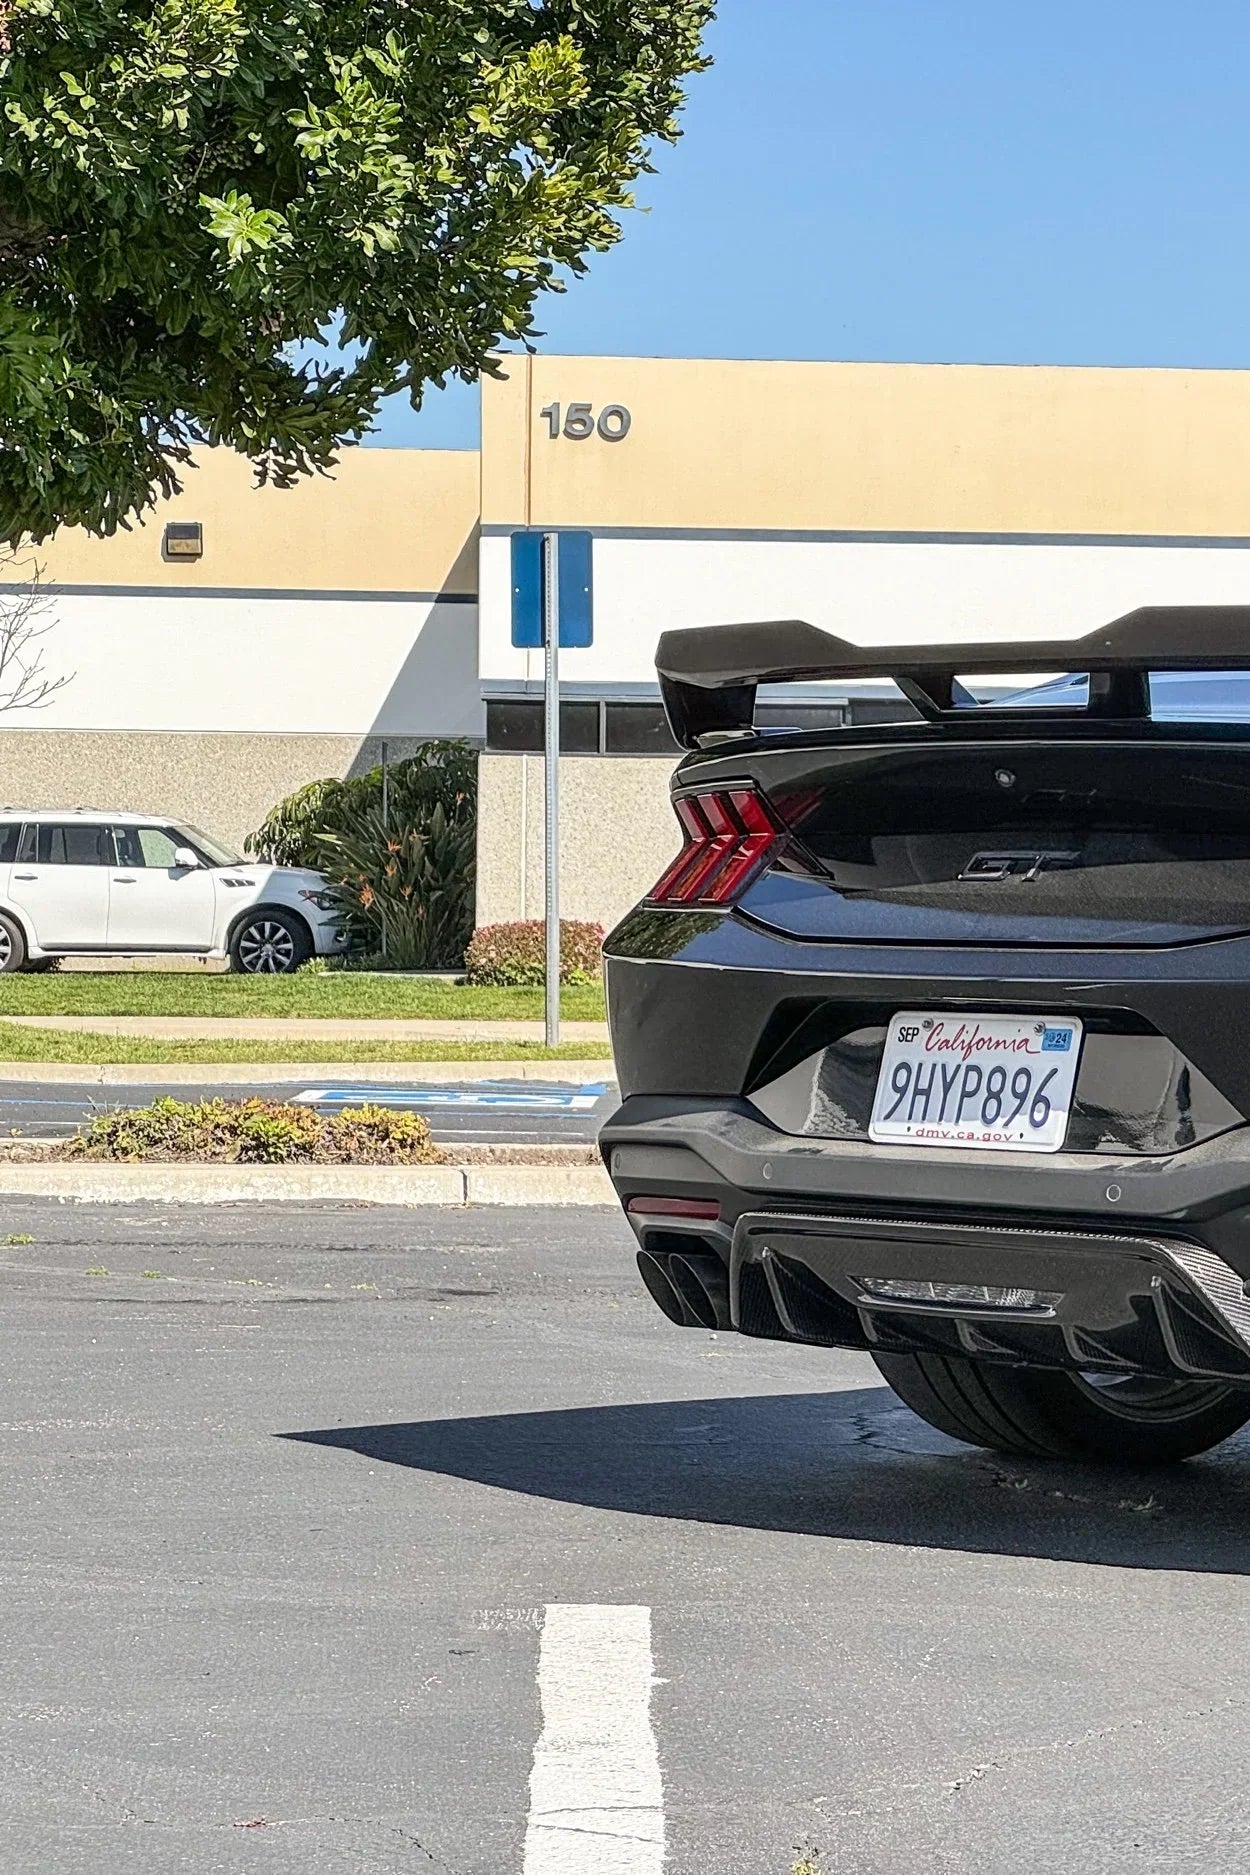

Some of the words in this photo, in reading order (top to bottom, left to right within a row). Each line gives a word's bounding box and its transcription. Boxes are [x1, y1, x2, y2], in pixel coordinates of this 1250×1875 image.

[540, 402, 631, 442] 150
[957, 851, 1081, 882] GT
[898, 1026, 919, 1043] SEP
[924, 1022, 1040, 1061] California
[1055, 1033, 1067, 1043] 24
[883, 1061, 1058, 1128] 9HYP896
[915, 1127, 1013, 1142] dmv.ca.gov
